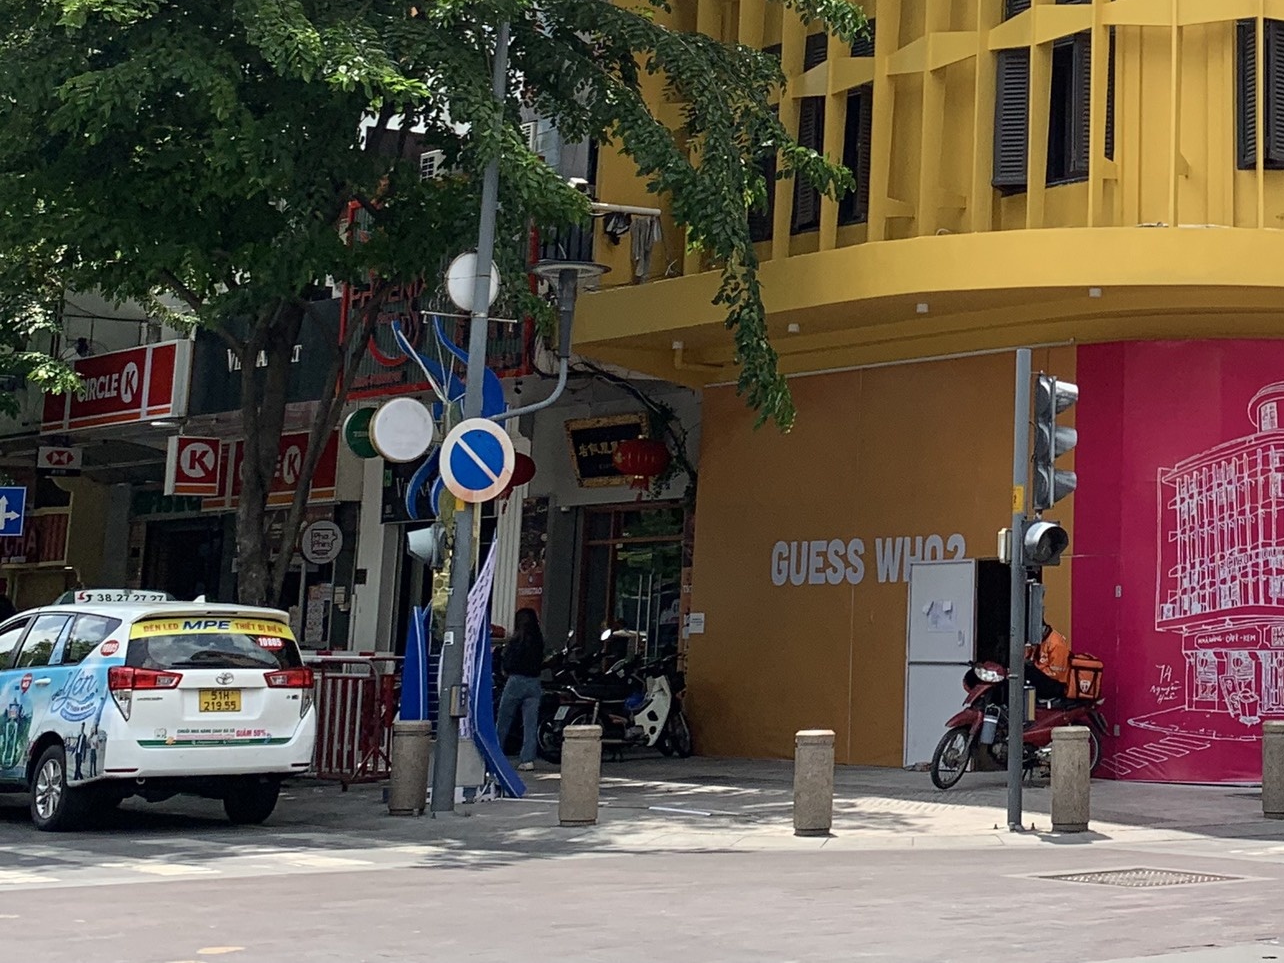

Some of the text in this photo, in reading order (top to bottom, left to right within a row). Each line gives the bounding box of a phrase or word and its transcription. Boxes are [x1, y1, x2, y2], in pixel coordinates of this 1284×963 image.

[77, 372, 119, 403] CIRCLE
[770, 538, 865, 586] GUESS
[163, 623, 179, 631] LED
[183, 620, 231, 630] MPE
[211, 690, 230, 700] 51H
[204, 701, 237, 712] 219.55
